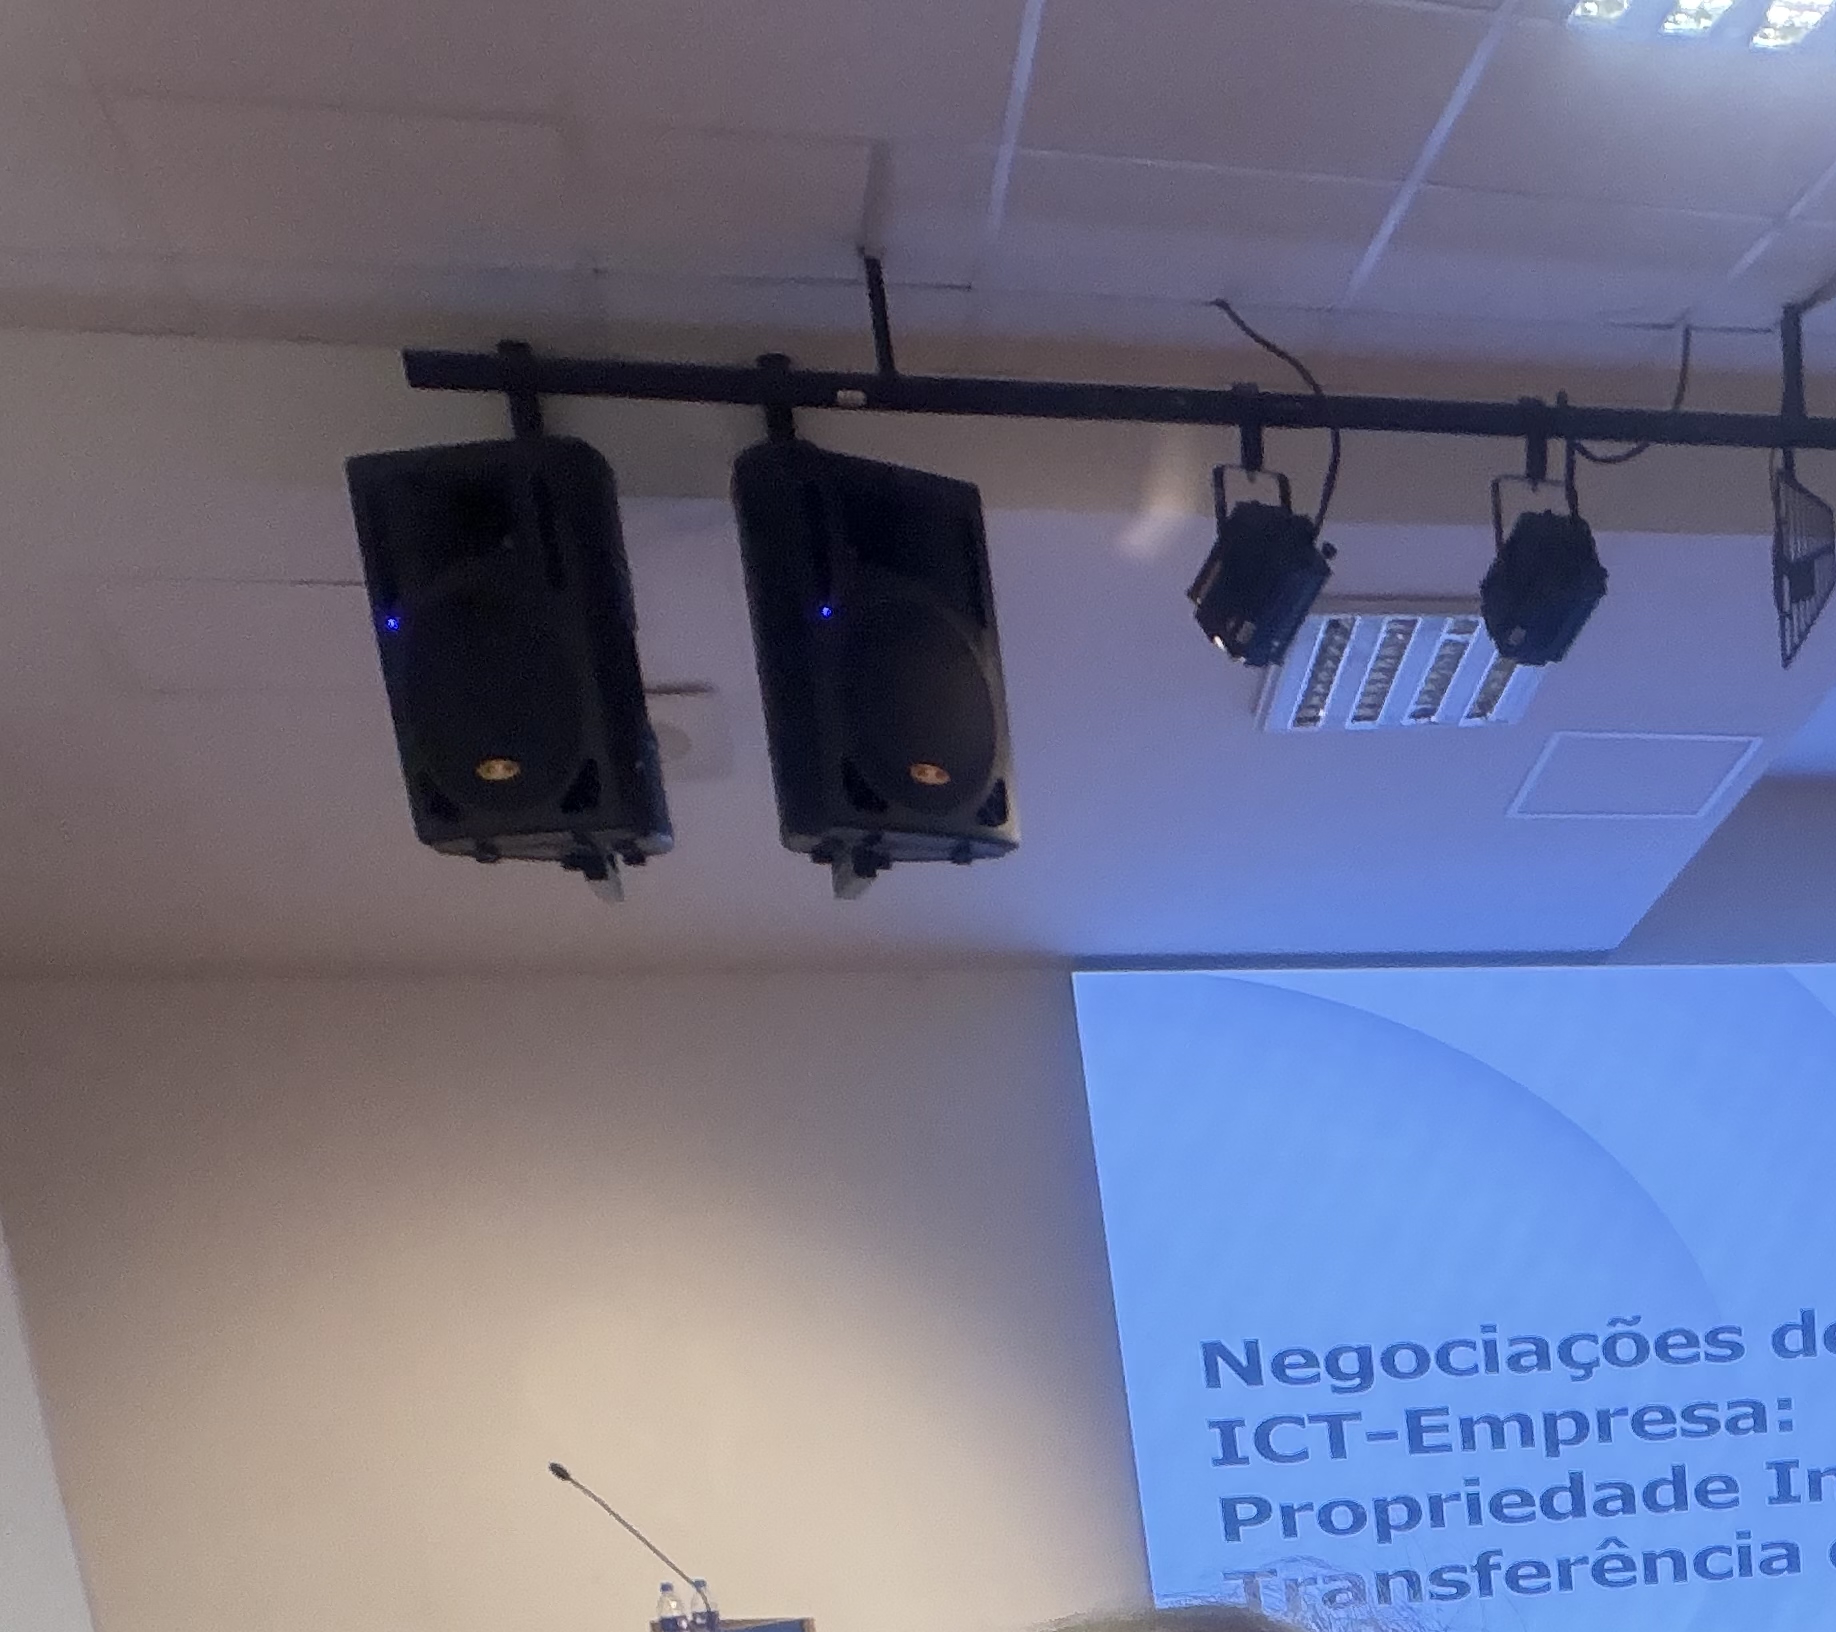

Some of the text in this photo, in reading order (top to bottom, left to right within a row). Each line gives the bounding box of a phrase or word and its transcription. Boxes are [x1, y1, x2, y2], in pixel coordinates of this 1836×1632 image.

[1200, 1314, 1746, 1395] Negociações
[1207, 1397, 1793, 1467] ICT-Empresa:
[1219, 1462, 1740, 1544] Propriedade
[1221, 1529, 1802, 1614] Transferência
